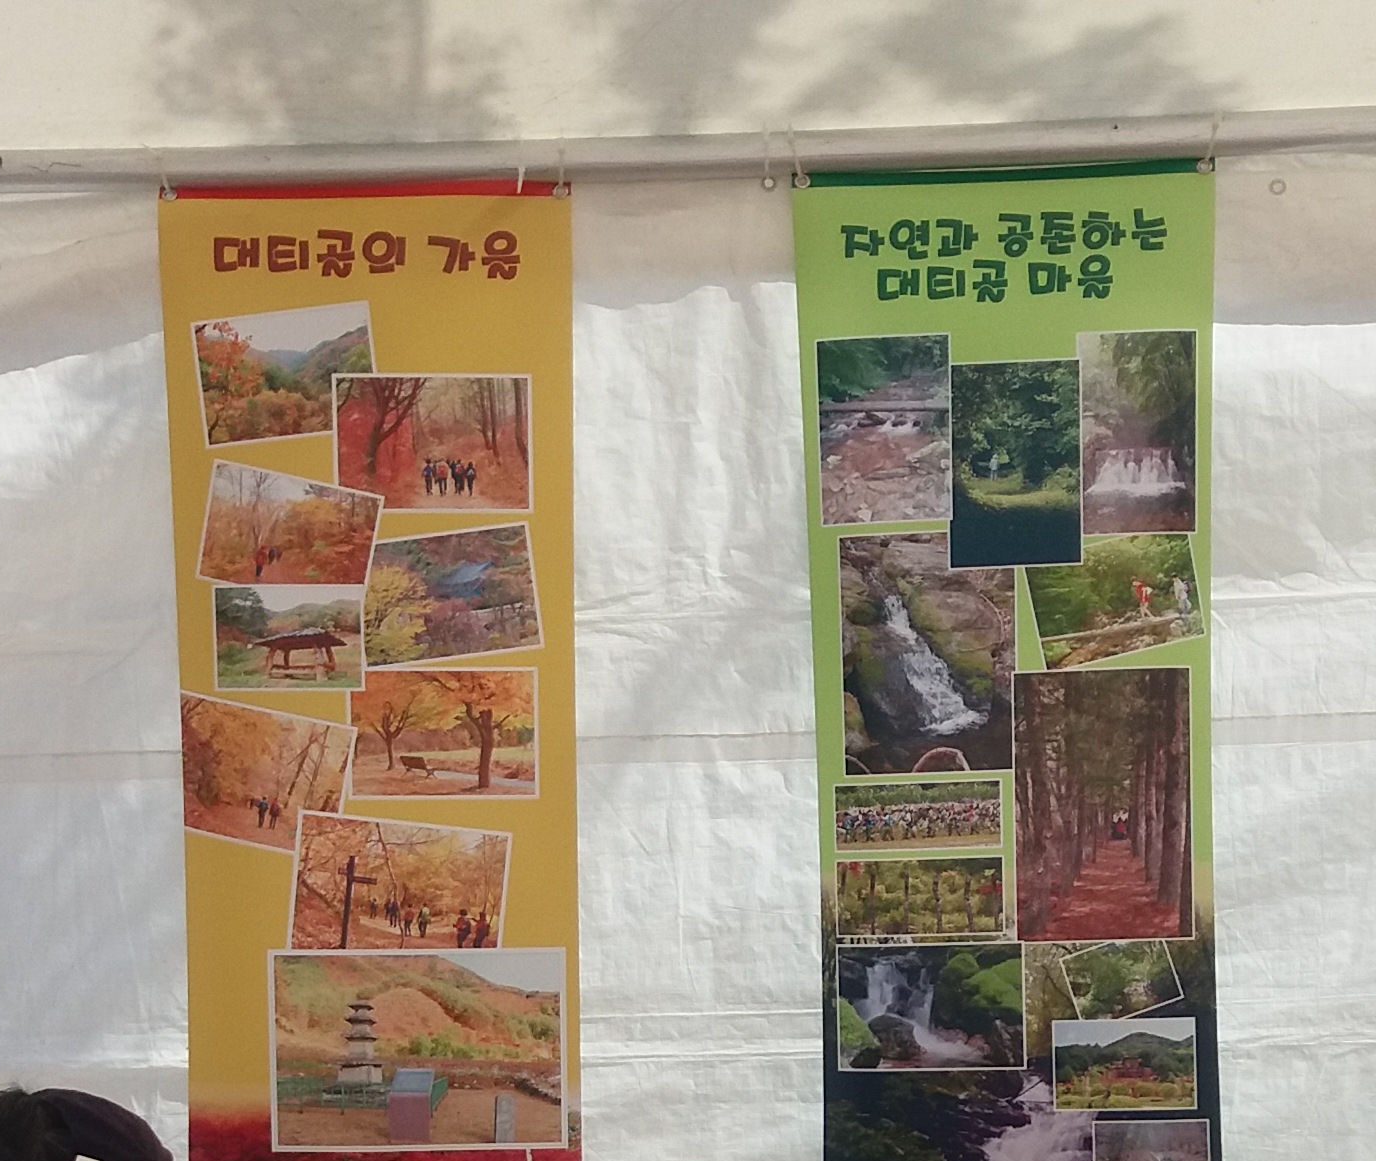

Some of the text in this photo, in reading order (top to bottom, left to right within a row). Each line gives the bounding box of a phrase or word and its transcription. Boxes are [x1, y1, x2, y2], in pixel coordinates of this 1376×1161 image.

[213, 229, 522, 280] 대티골의 가을
[840, 207, 1168, 259] 자연과 공존하는
[876, 254, 1114, 303] 대티골 마을
